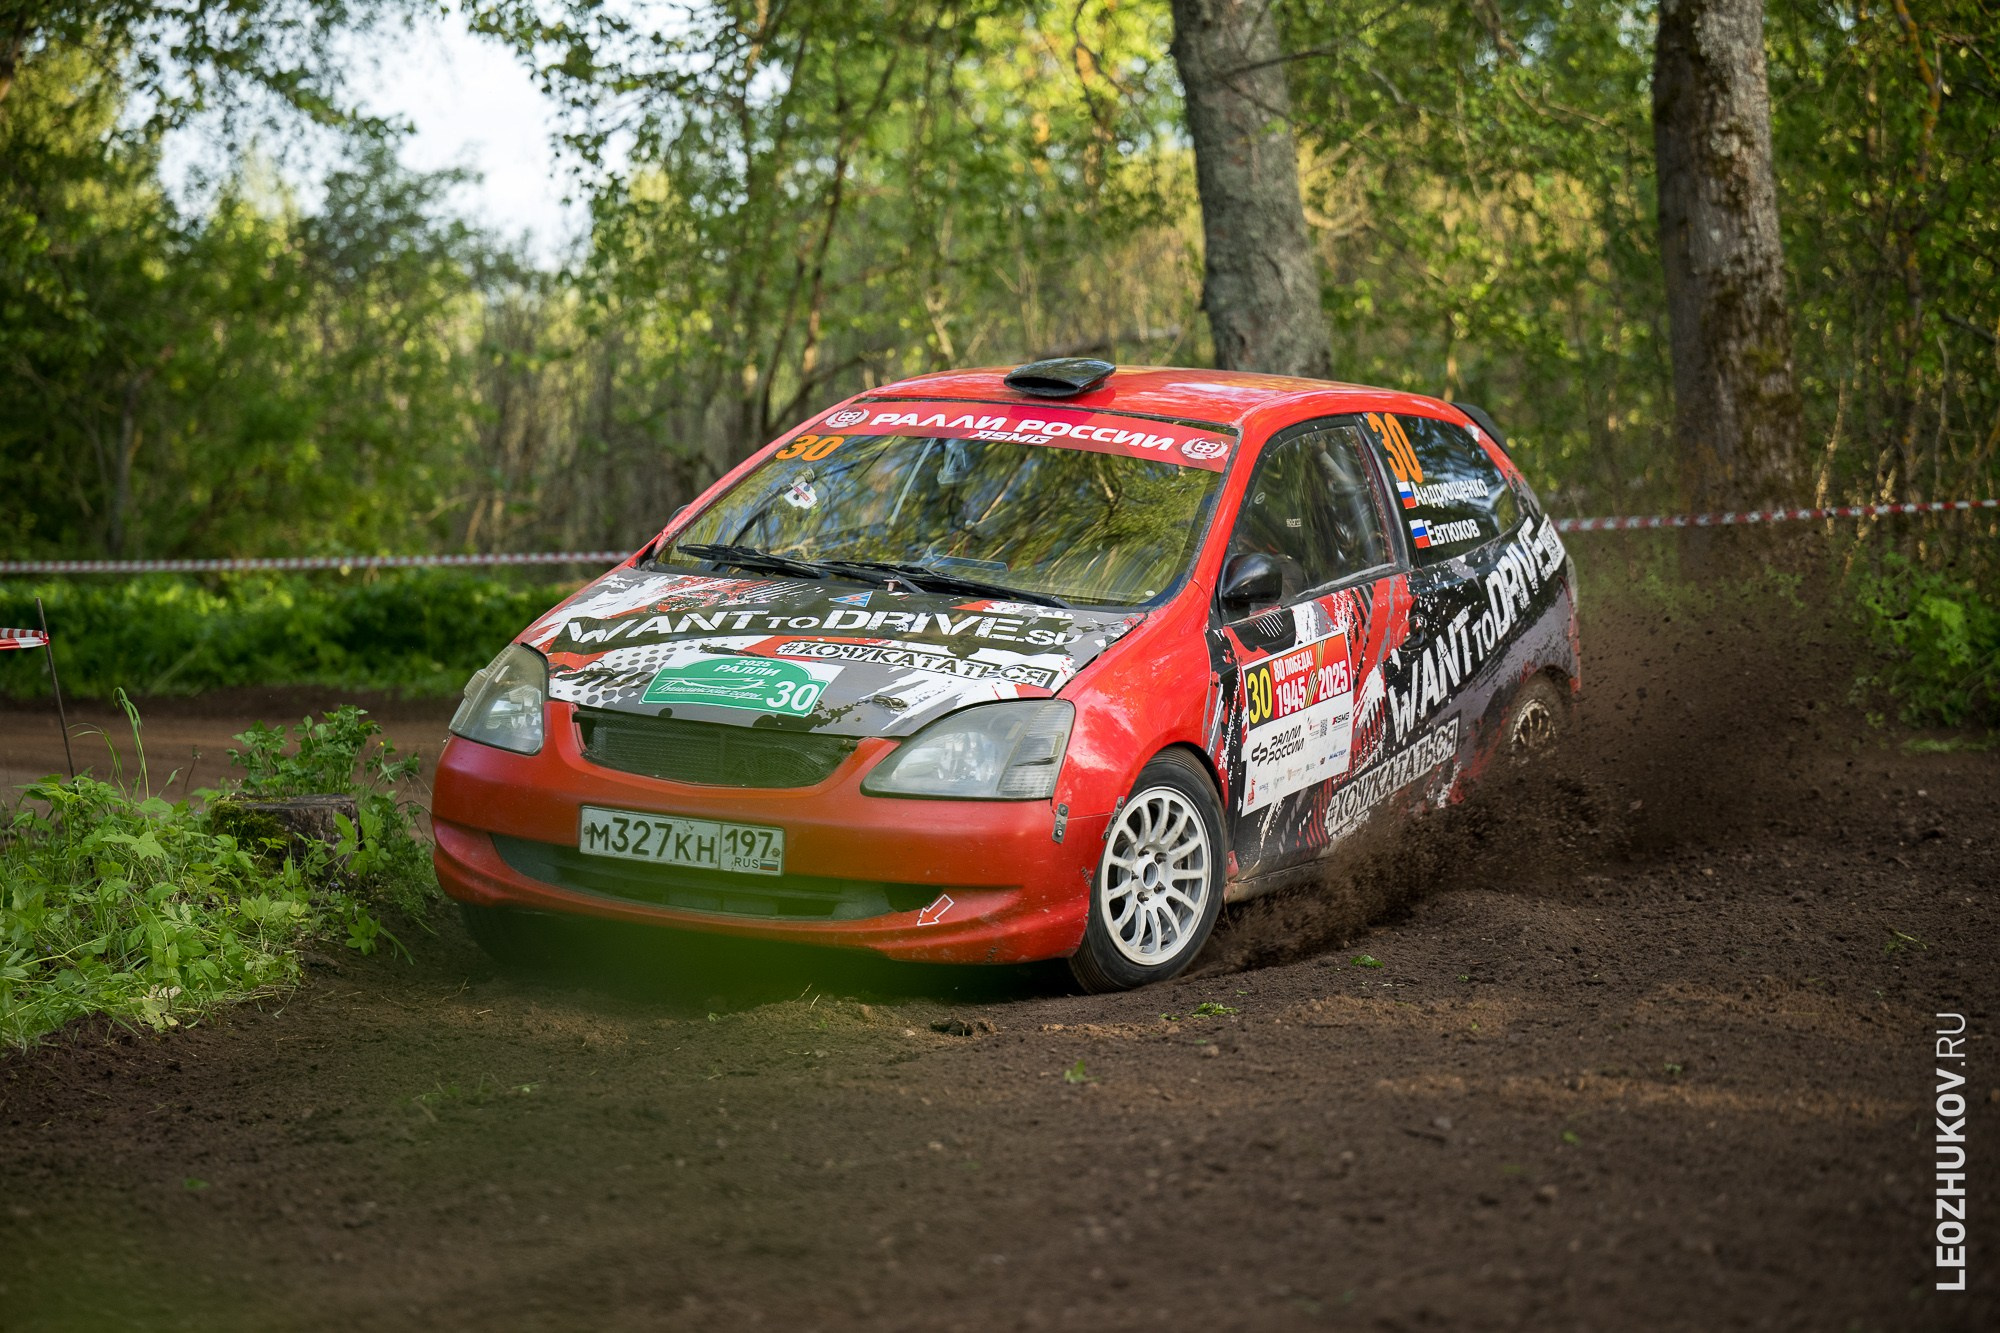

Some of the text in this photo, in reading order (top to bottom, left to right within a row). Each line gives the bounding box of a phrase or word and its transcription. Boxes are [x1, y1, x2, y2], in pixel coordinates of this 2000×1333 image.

[869, 412, 1175, 451] РАЛЛИ РОССИИ
[776, 435, 845, 462] 30
[1367, 412, 1424, 484] 30
[1410, 478, 1489, 509] Андрющенко
[1424, 519, 1481, 547] Евтюхов
[567, 610, 769, 643] WANT
[713, 664, 782, 677] РАЛЛИ
[735, 659, 772, 668] 2025
[781, 641, 1049, 684] #ХОЧУКАТАТЬСЯ
[1273, 649, 1314, 683] 80 ПОБЕДА!
[1387, 605, 1472, 744] WANT
[766, 680, 820, 711] 30
[1247, 667, 1272, 724] 30
[1276, 660, 1348, 717] 1945 2025
[1267, 737, 1305, 766] РОССИИ
[1270, 725, 1302, 750] РАЛЛИ
[589, 816, 774, 864] М327КН 197
[734, 856, 759, 869] RUS
